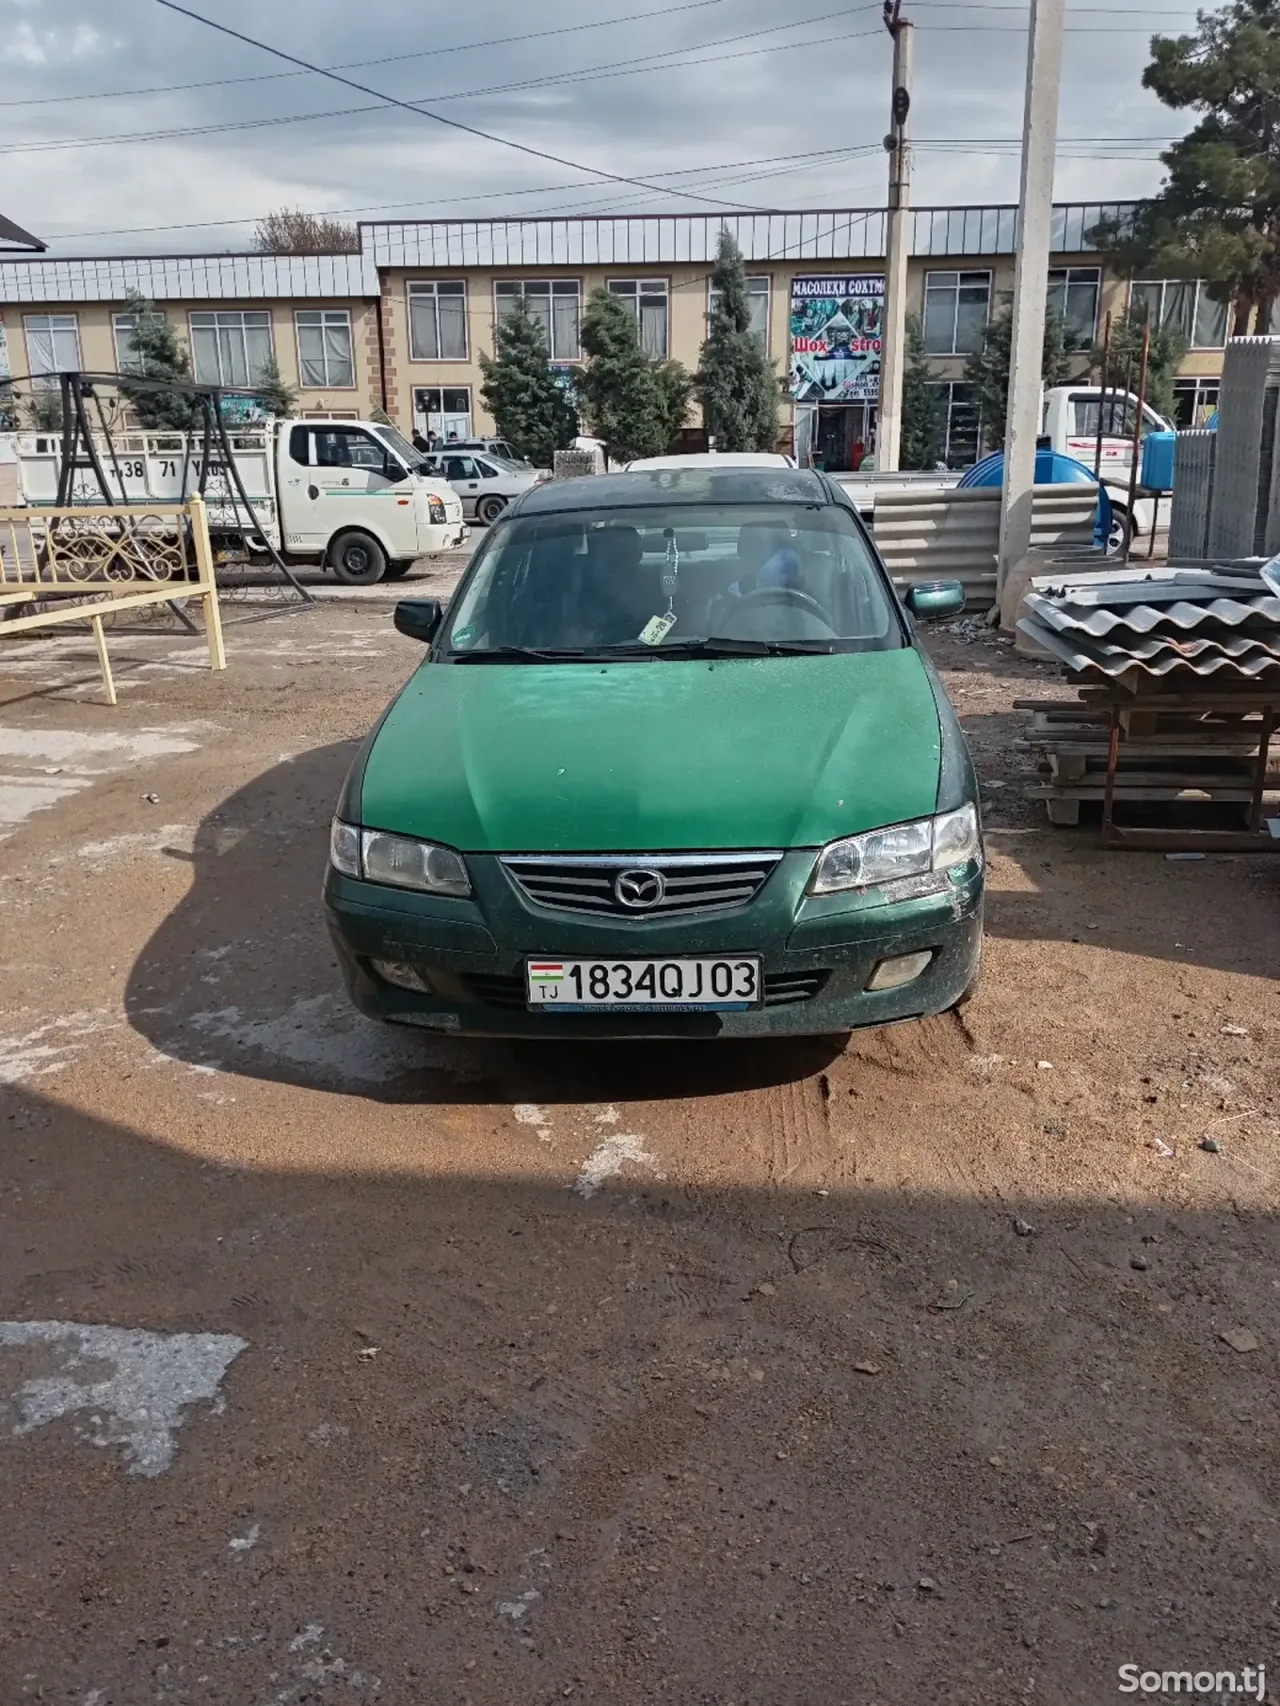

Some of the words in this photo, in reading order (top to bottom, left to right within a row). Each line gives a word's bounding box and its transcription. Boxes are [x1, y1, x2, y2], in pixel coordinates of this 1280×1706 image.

[124, 461, 144, 478] 38
[159, 461, 176, 477] 71
[538, 985, 559, 999] TJ
